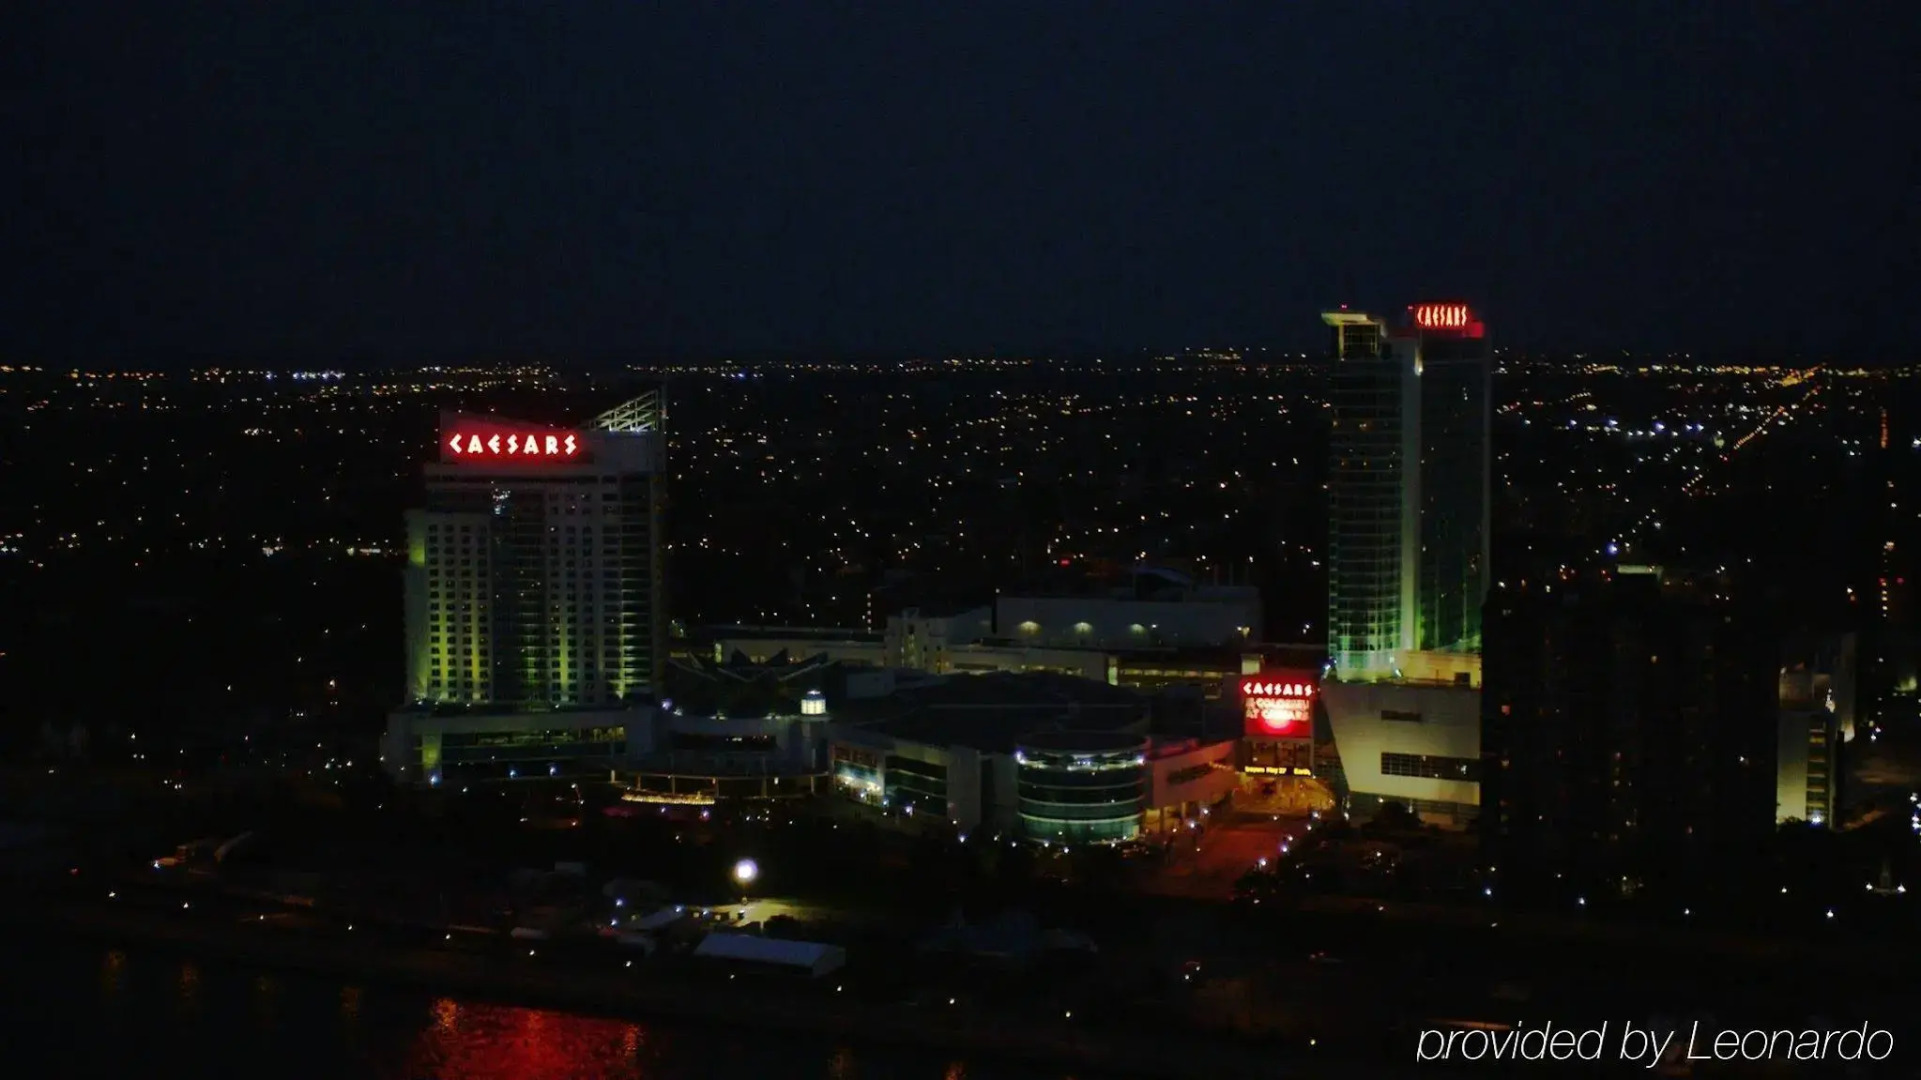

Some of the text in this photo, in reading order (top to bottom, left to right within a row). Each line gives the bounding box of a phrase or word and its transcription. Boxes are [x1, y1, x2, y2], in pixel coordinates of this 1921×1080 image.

[1417, 305, 1467, 327] CAESARS
[449, 433, 577, 455] CAESARS
[1243, 682, 1313, 697] CAESARS
